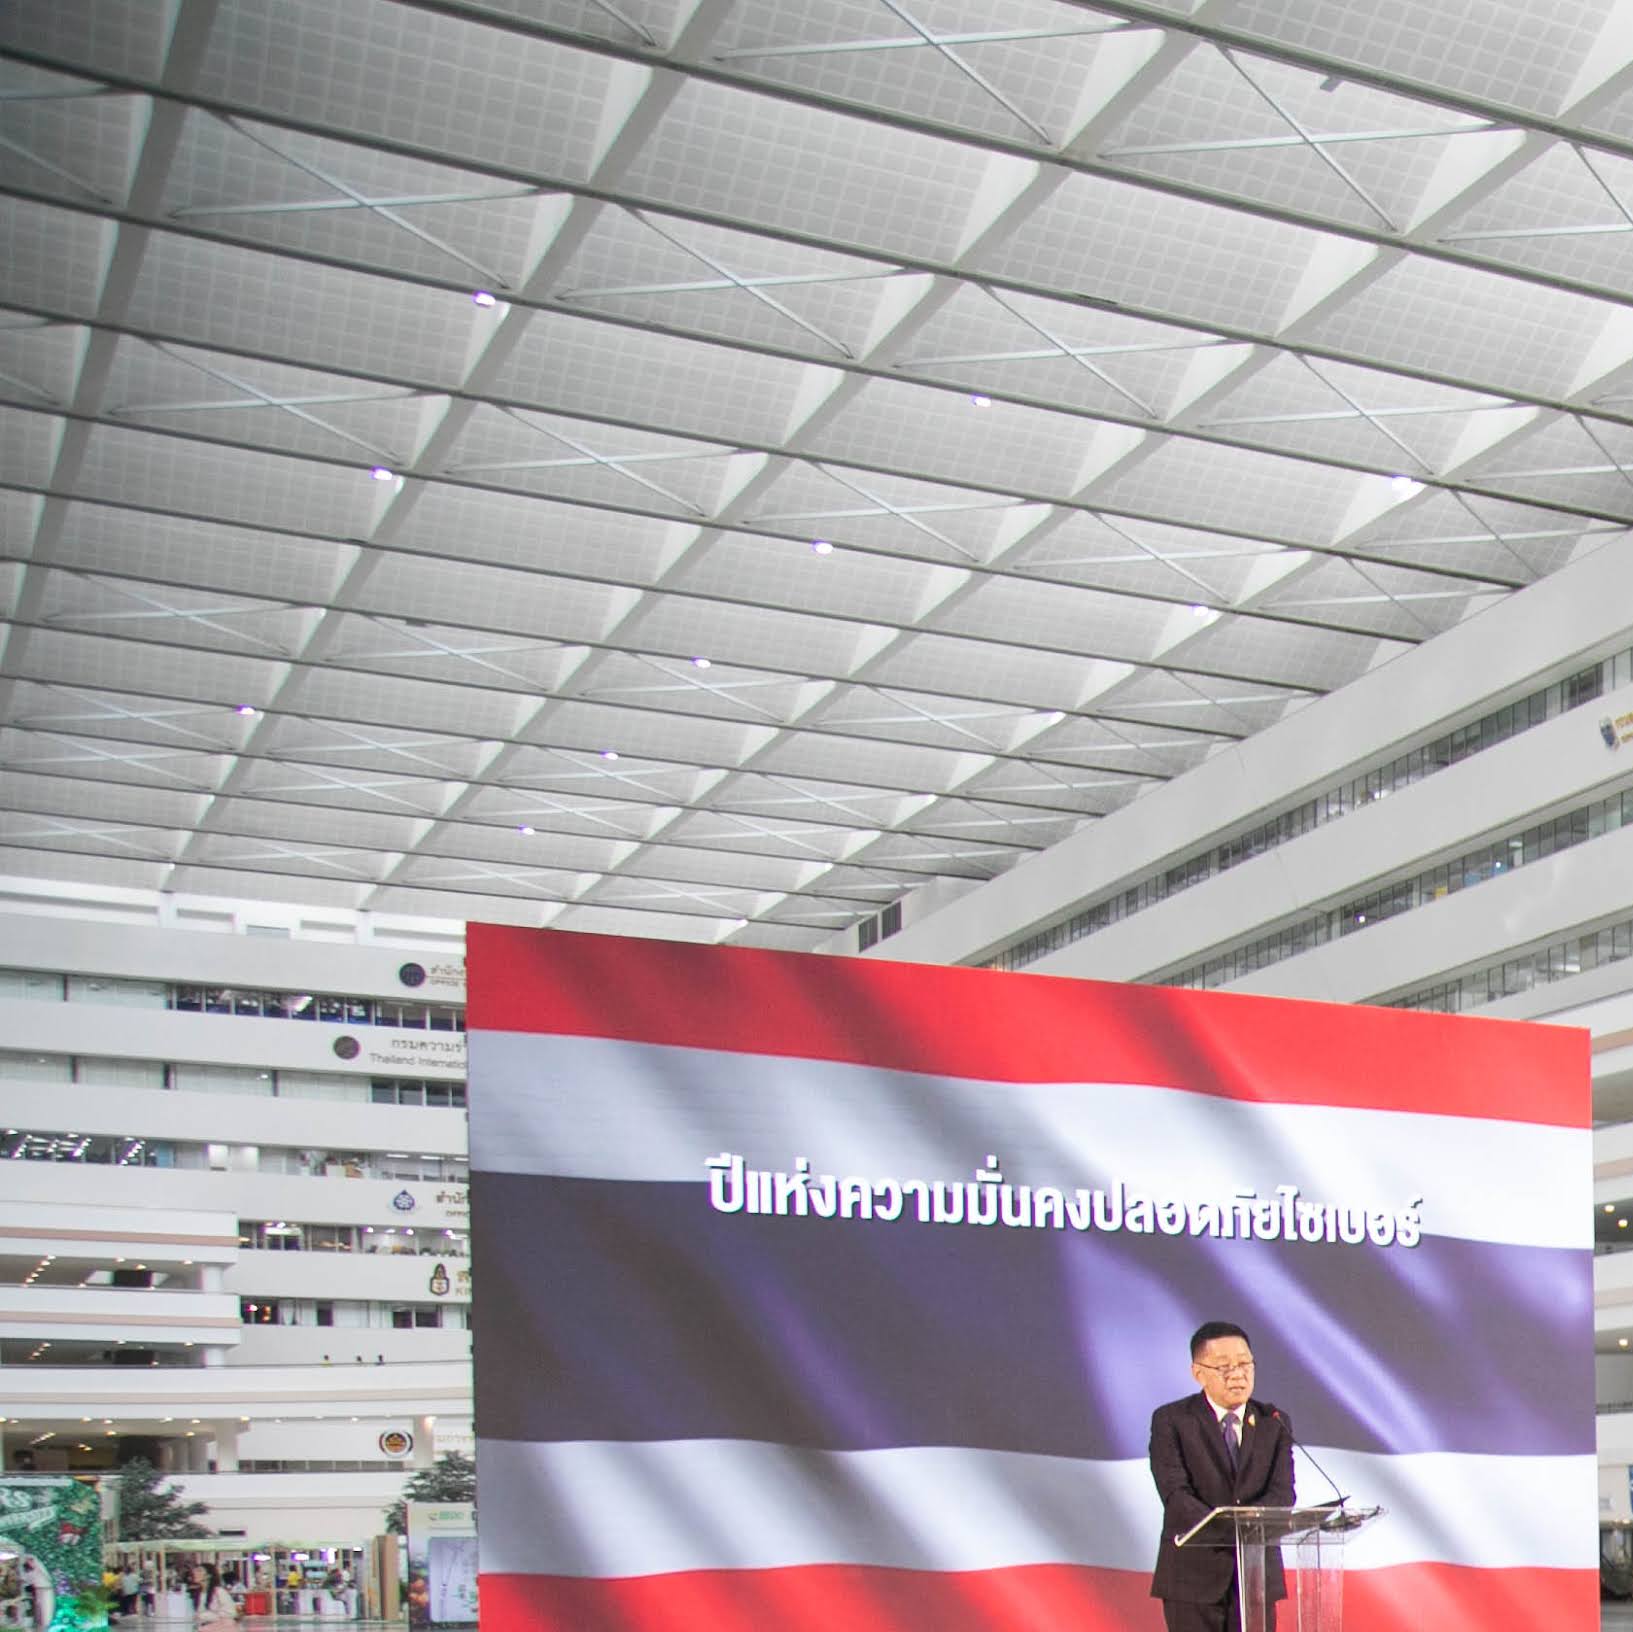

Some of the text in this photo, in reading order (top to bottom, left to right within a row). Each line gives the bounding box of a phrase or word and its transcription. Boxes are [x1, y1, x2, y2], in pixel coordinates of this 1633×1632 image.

[419, 1056, 466, 1070] Internatio
[704, 1152, 1425, 1249] ปีแห่งความมั่นคงปลอดภัยไซเบอร์
